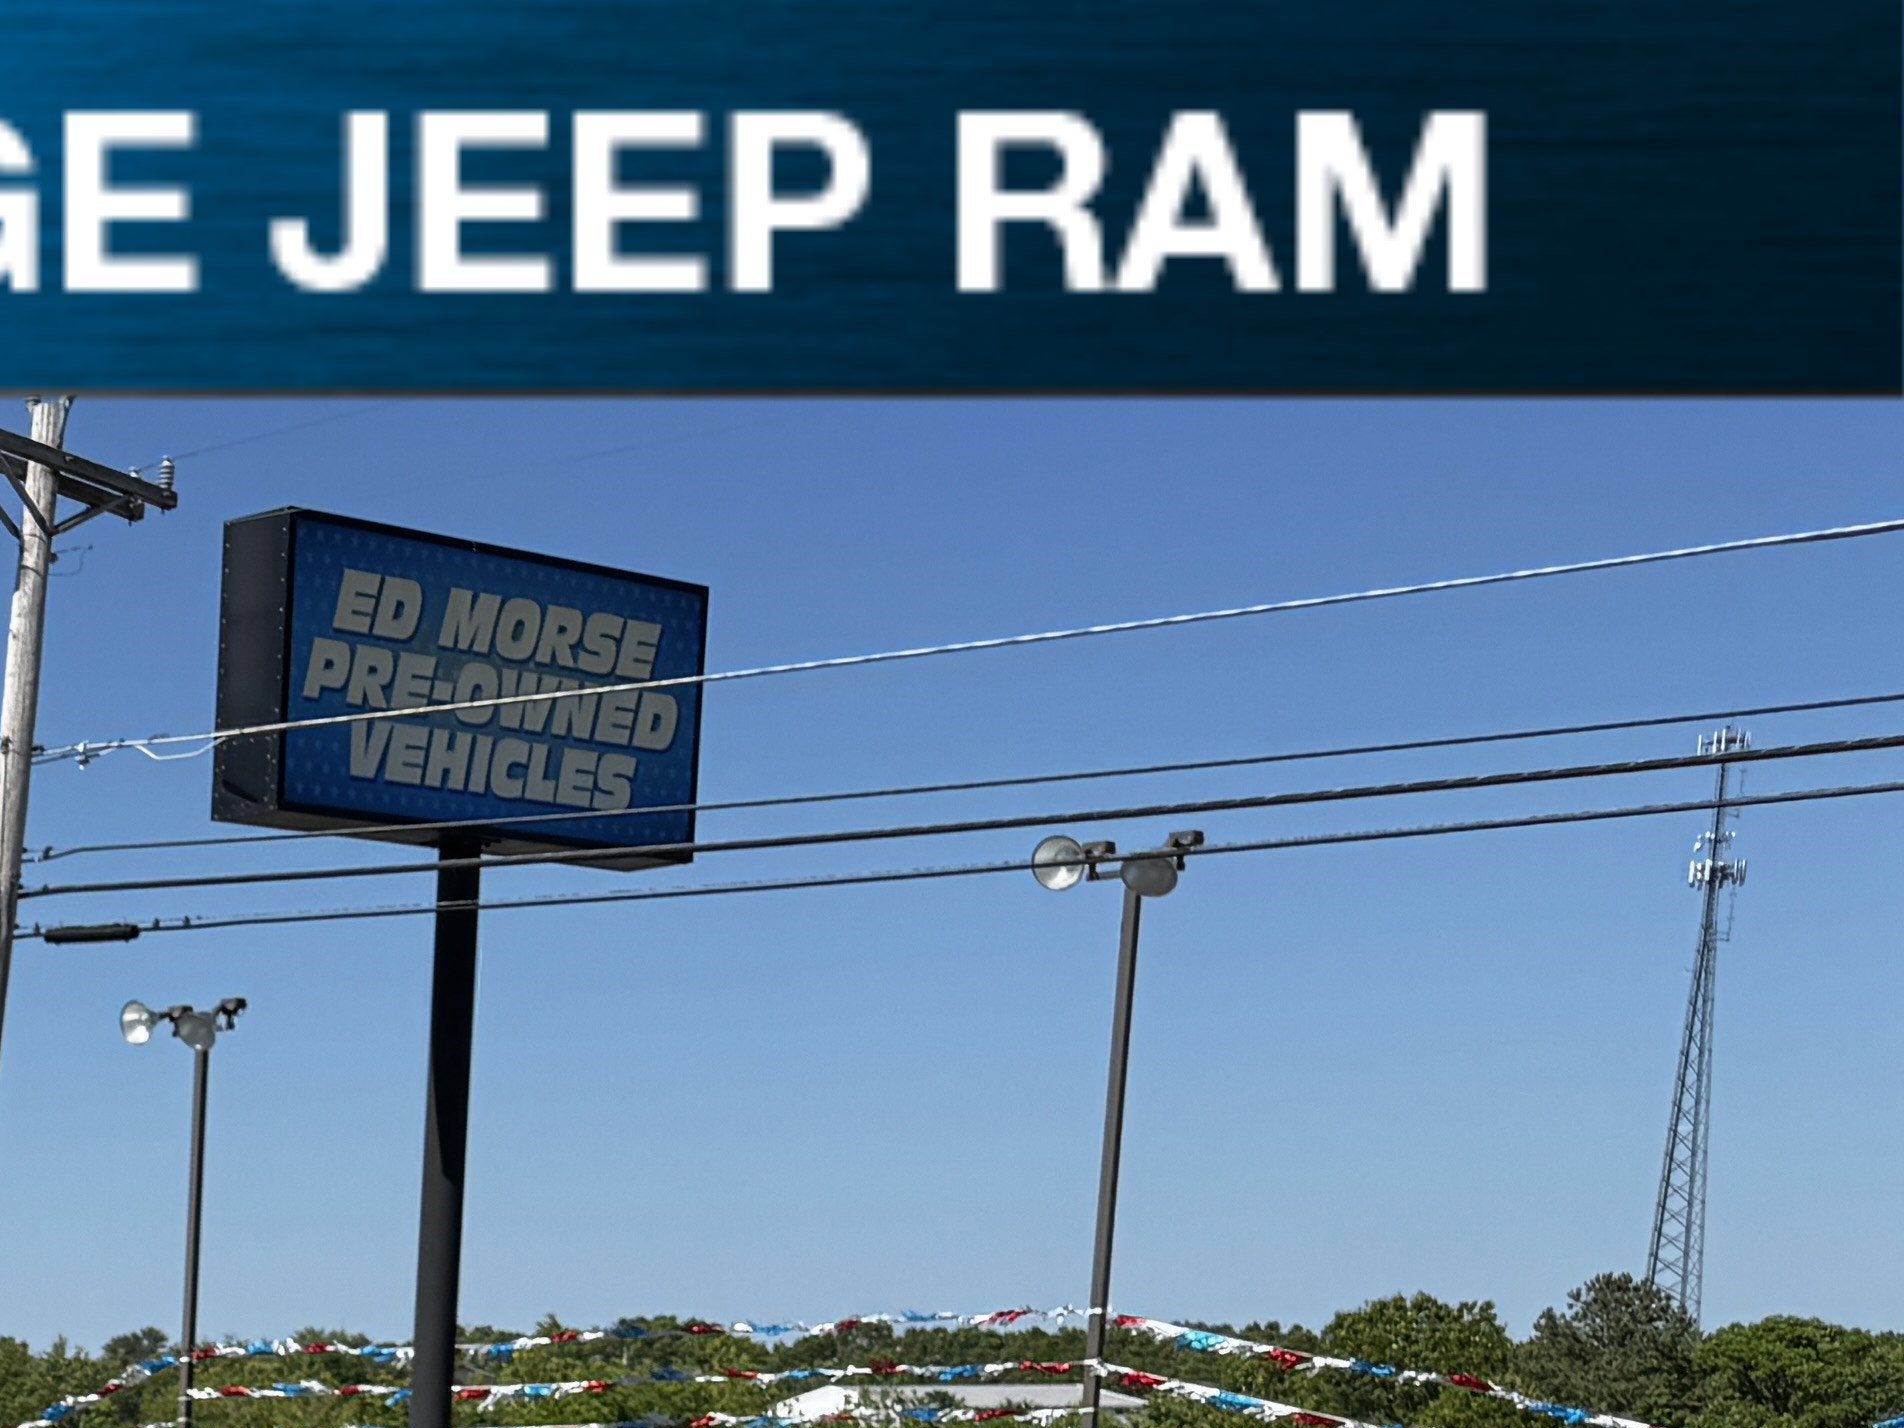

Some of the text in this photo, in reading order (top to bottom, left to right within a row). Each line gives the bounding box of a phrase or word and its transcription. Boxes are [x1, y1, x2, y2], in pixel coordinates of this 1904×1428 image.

[333, 568, 662, 681] ED MORSE
[302, 636, 678, 752] PRE-OWNED
[349, 718, 638, 811] VEHICLES
